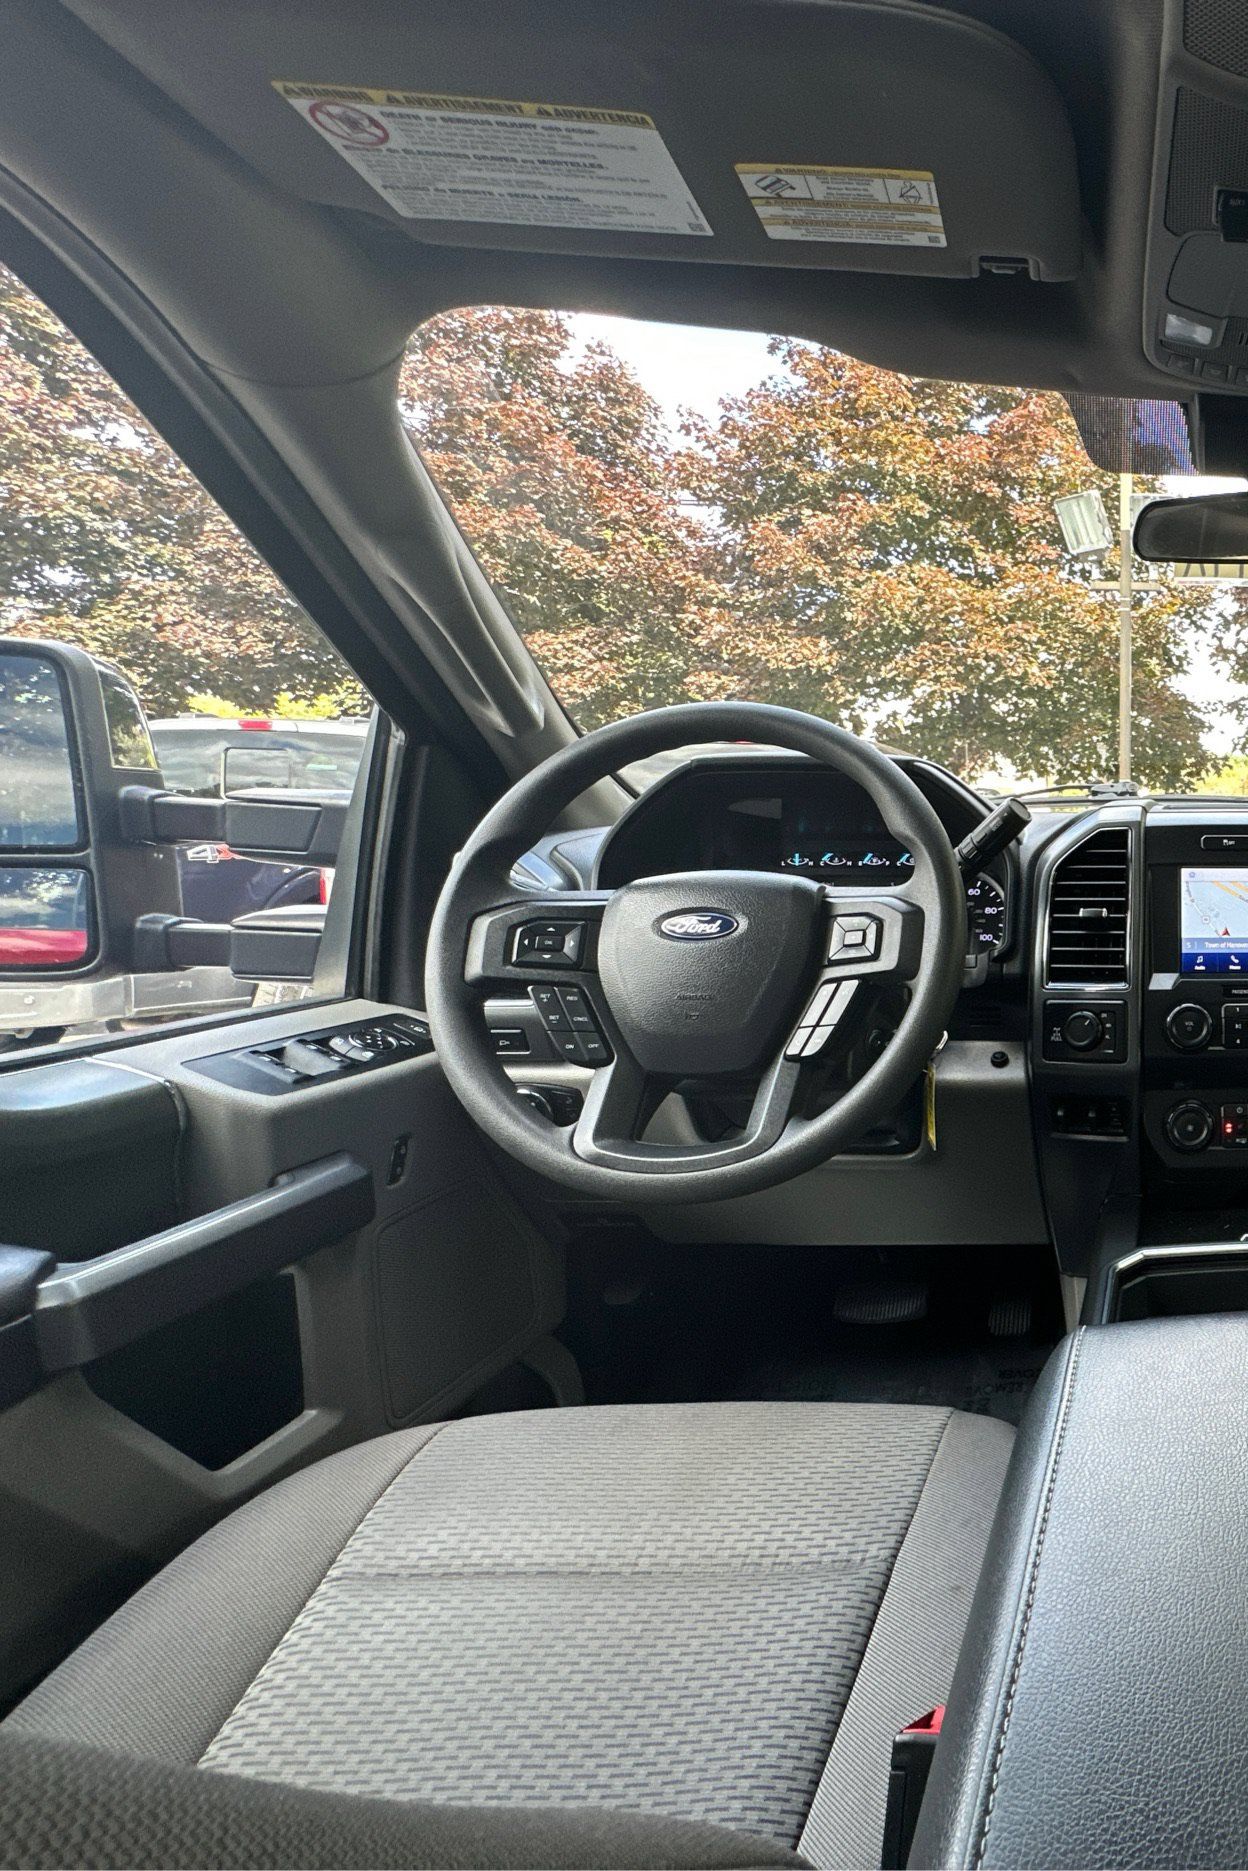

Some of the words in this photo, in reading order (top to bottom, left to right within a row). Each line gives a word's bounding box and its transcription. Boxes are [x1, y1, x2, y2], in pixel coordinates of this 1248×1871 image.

[553, 107, 652, 127] ADVERTENCIA
[967, 888, 981, 896] 60
[984, 907, 998, 915] 80
[665, 914, 722, 933] Ford
[979, 933, 993, 941] 100
